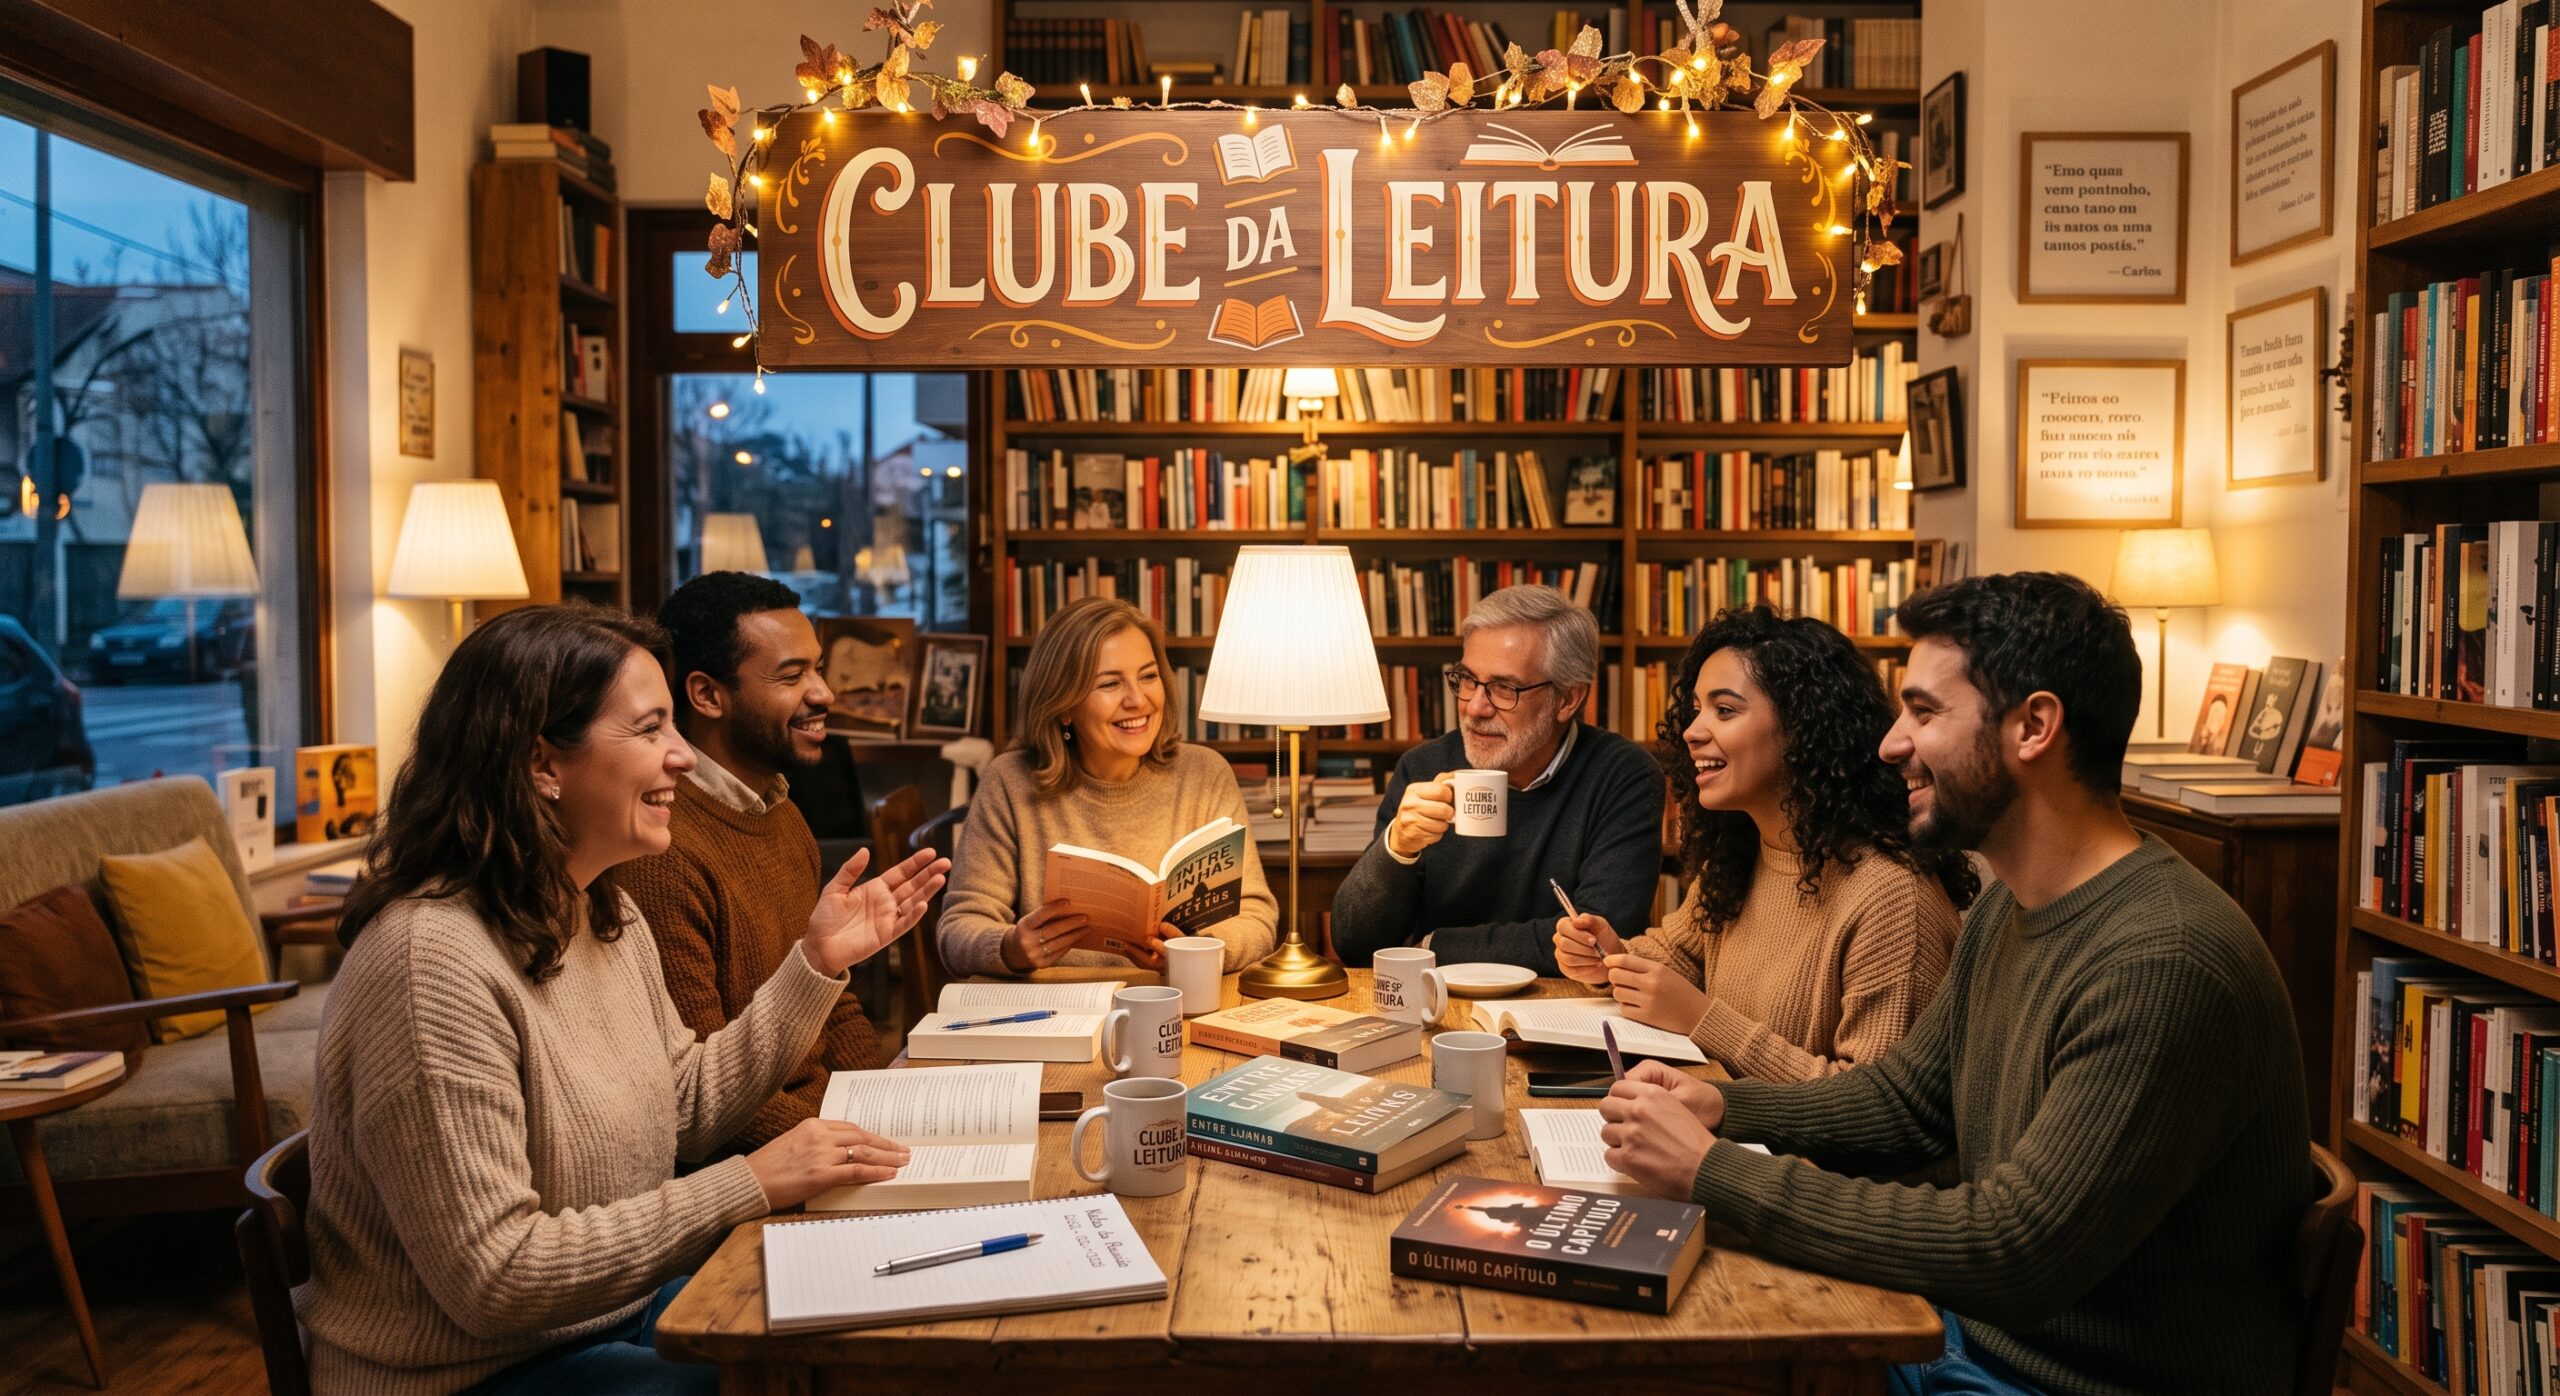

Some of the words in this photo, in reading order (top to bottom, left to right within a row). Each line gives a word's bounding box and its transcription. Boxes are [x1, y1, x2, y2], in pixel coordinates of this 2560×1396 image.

[818, 147, 1200, 340] CLUBE
[1226, 206, 1299, 272] DA
[1316, 148, 1798, 348] LEITURA
[1139, 1127, 1178, 1146] CLUBE
[1192, 1119, 1226, 1135] ENTRE
[1529, 1194, 1587, 1238] ÚLTIMO
[1561, 1199, 1622, 1256] CAPÍTULO
[1525, 1239, 1552, 1250] O
[1408, 1251, 1418, 1266] O
[1423, 1250, 1478, 1274] ÚLTIMO
[1483, 1262, 1557, 1287] CAPÍTULO
